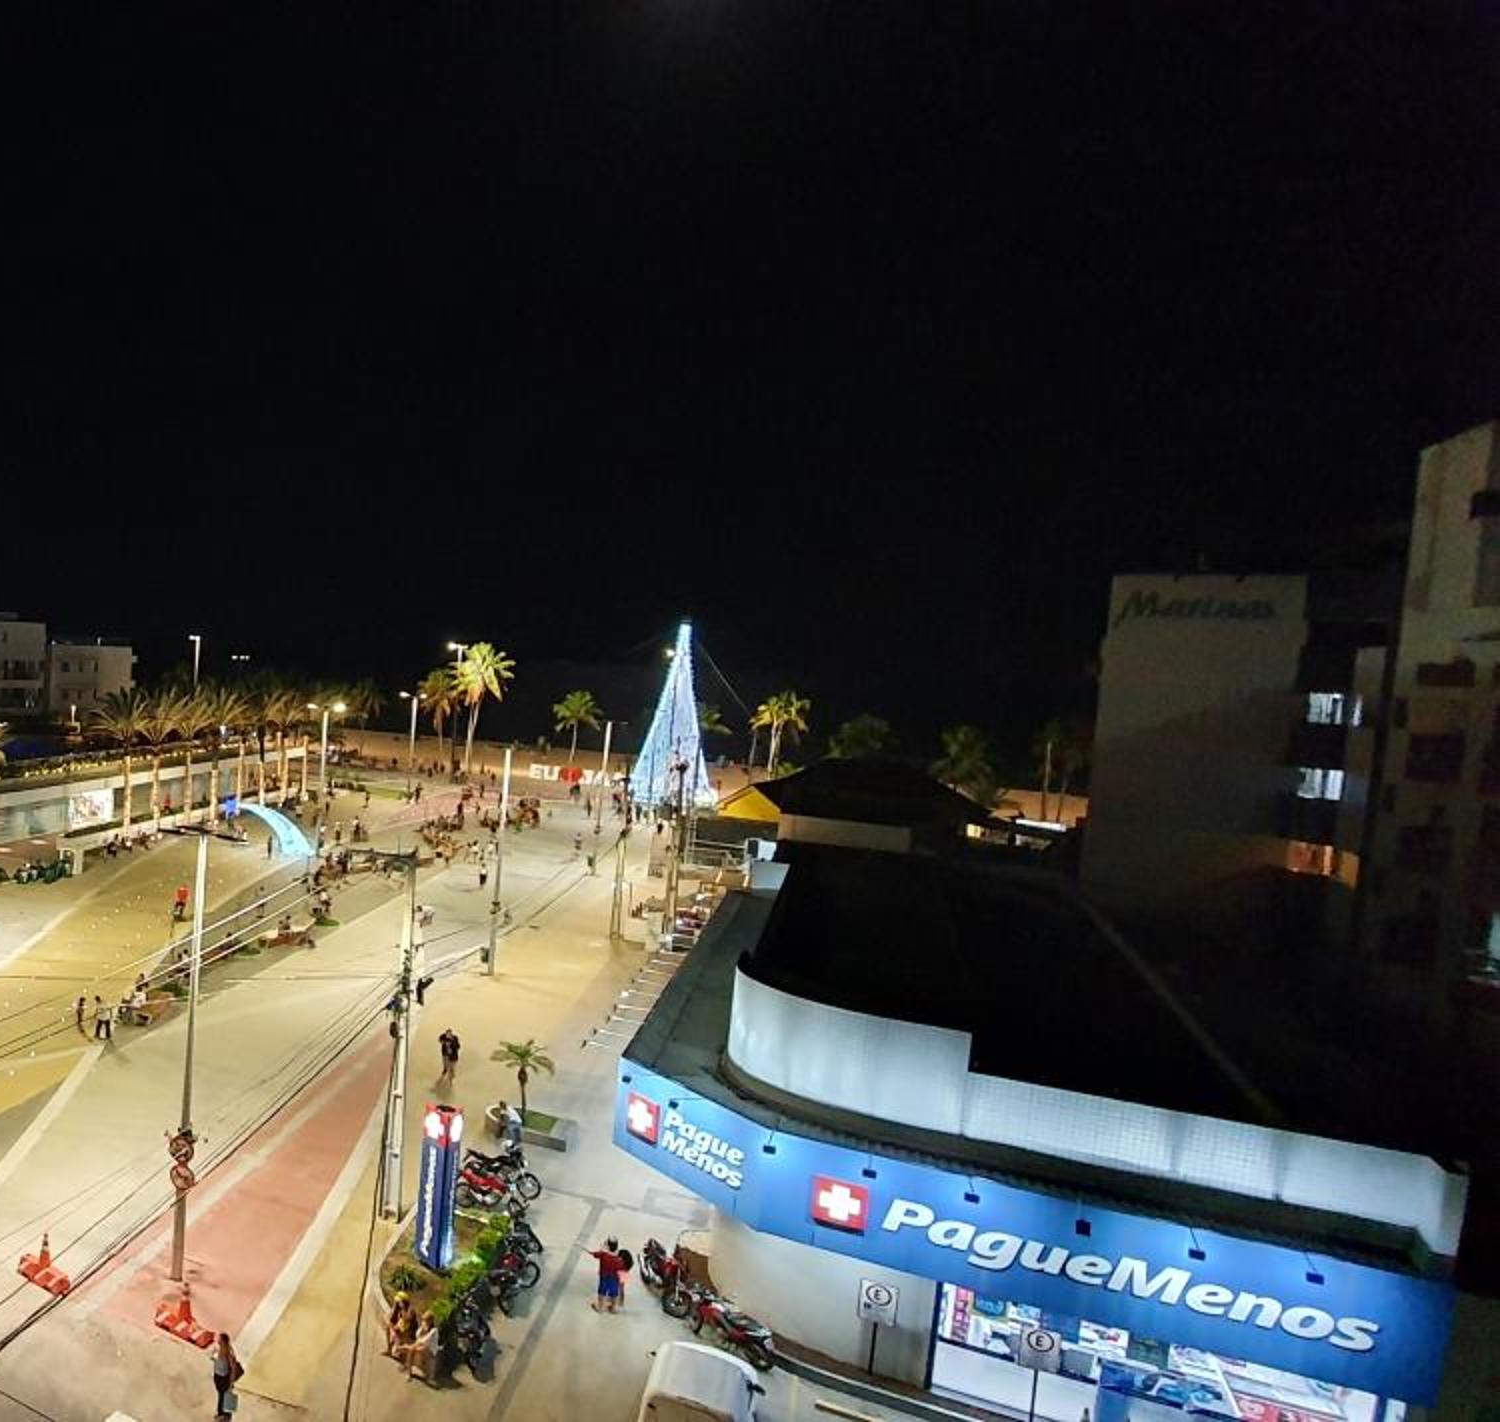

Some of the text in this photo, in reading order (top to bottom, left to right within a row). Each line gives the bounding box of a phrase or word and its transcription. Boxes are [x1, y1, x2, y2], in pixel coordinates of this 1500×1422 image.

[662, 1130, 743, 1188] Menos
[664, 1108, 745, 1166] Pague
[880, 1198, 1382, 1353] PagueMenos
